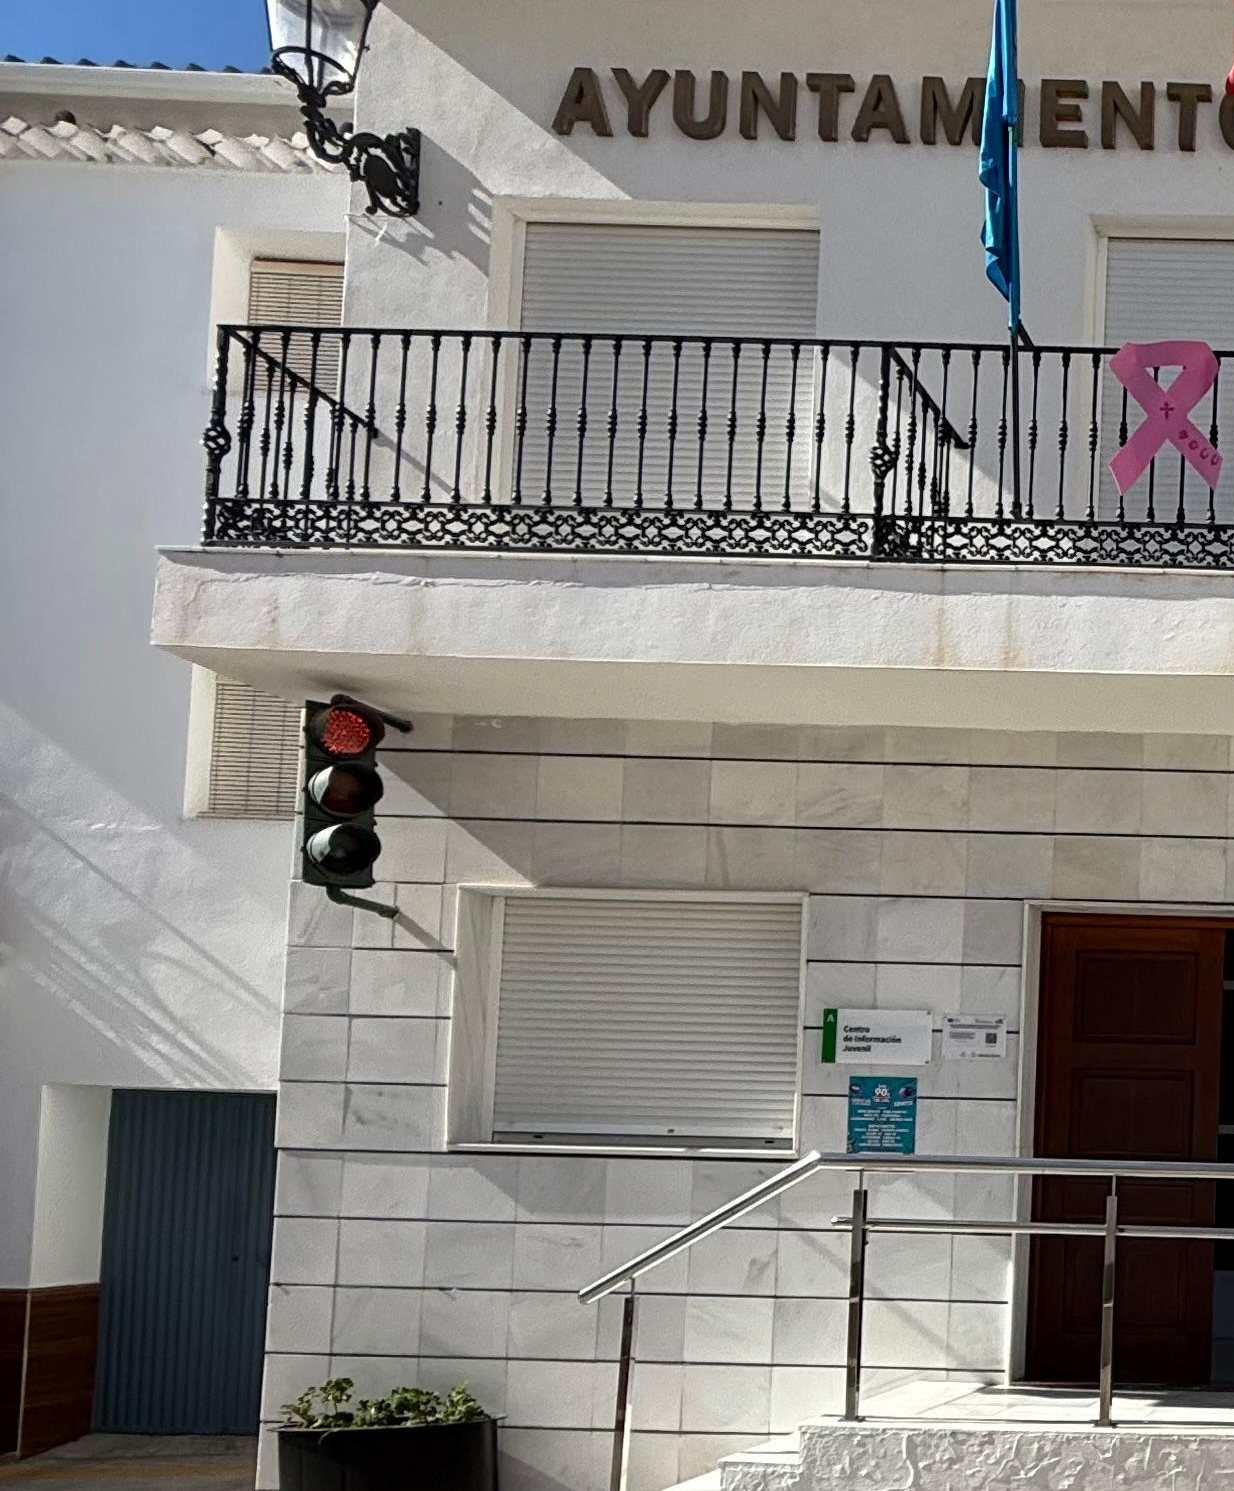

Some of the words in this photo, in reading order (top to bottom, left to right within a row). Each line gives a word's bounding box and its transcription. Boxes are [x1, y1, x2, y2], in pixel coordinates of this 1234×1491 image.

[843, 1025, 871, 1034] Centro
[843, 1035, 854, 1043] de
[854, 1035, 902, 1044] Información
[843, 1045, 872, 1053] Juvenil
